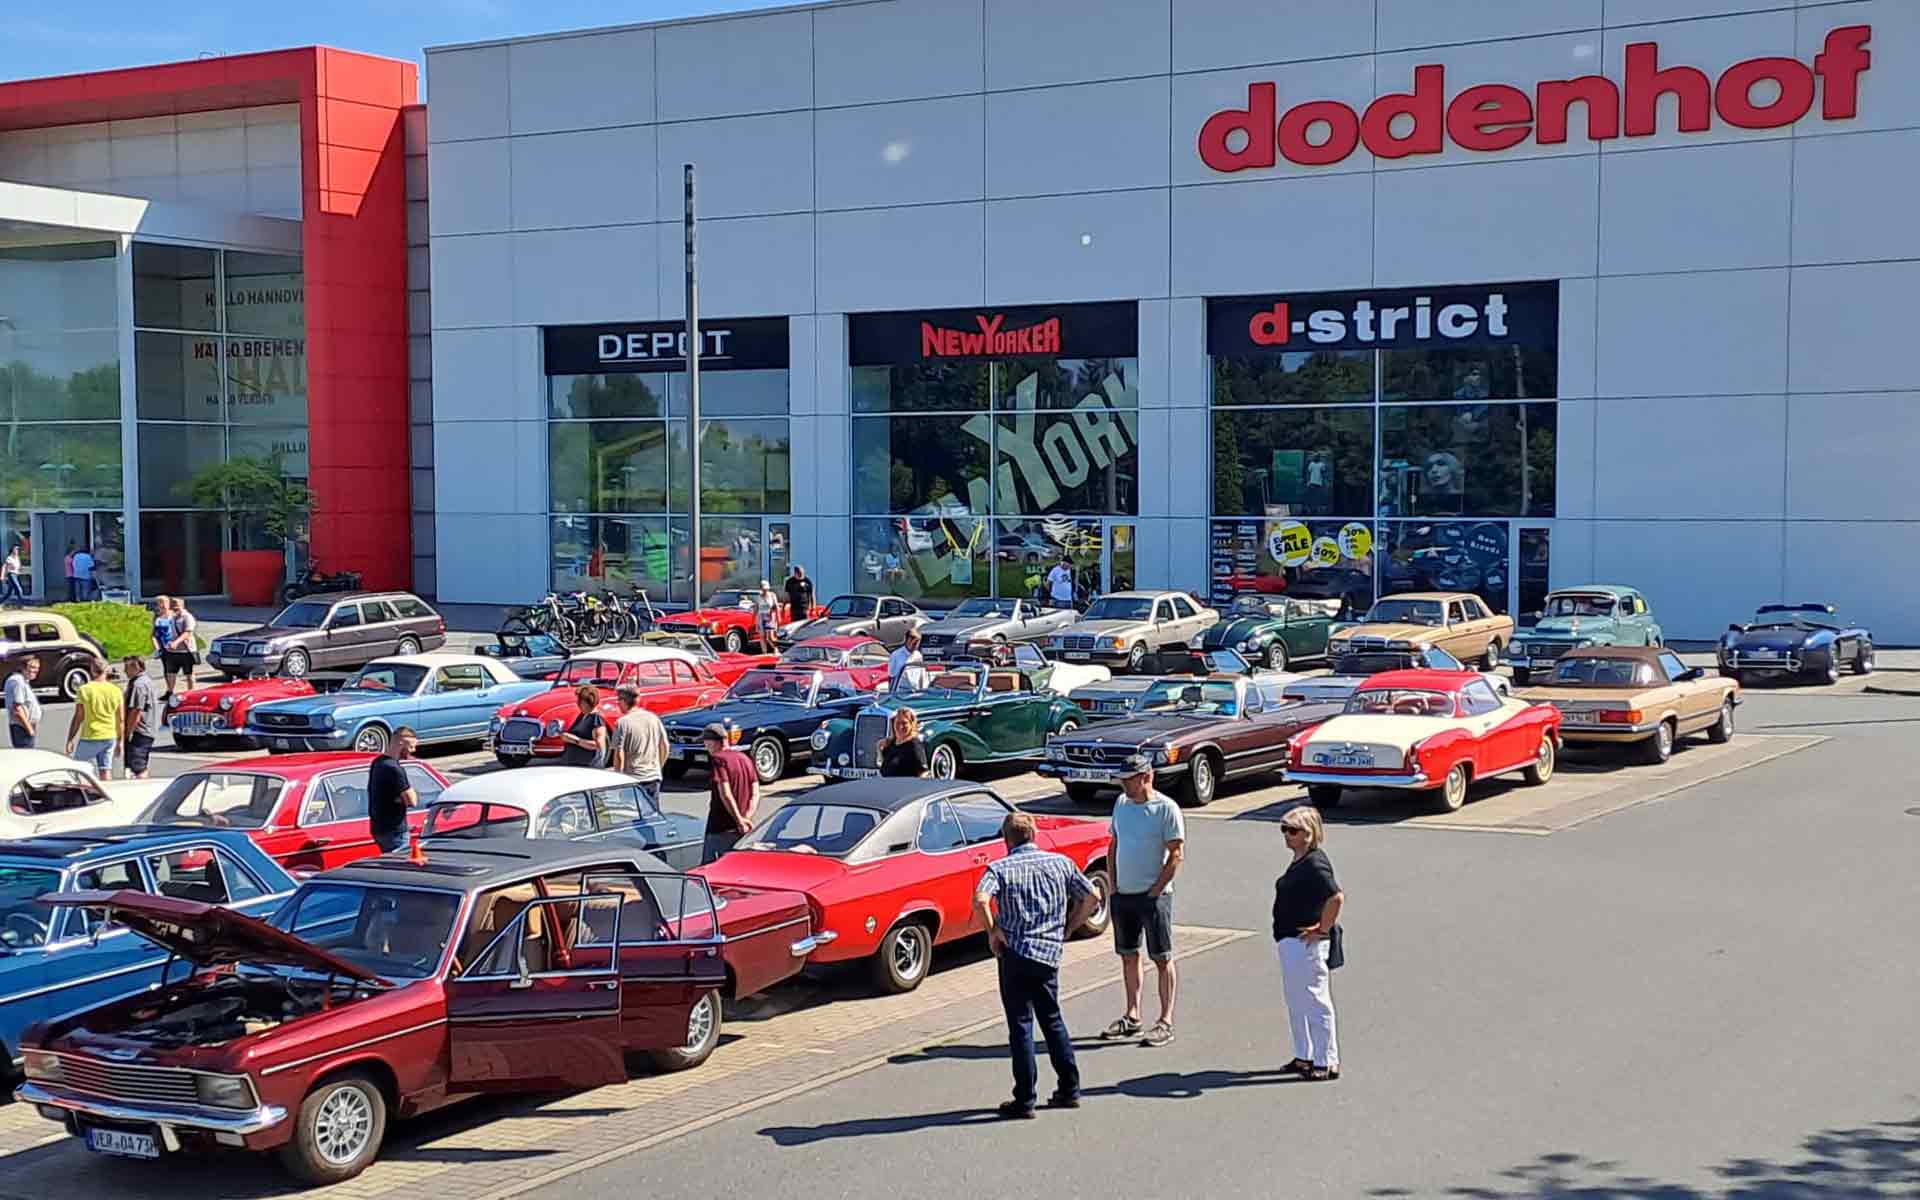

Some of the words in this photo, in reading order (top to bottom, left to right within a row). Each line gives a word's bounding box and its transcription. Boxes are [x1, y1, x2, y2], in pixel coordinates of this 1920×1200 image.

[1199, 25, 1871, 172] dodenhof
[1250, 294, 1508, 344] d-strict
[1275, 538, 1309, 556] SALE
